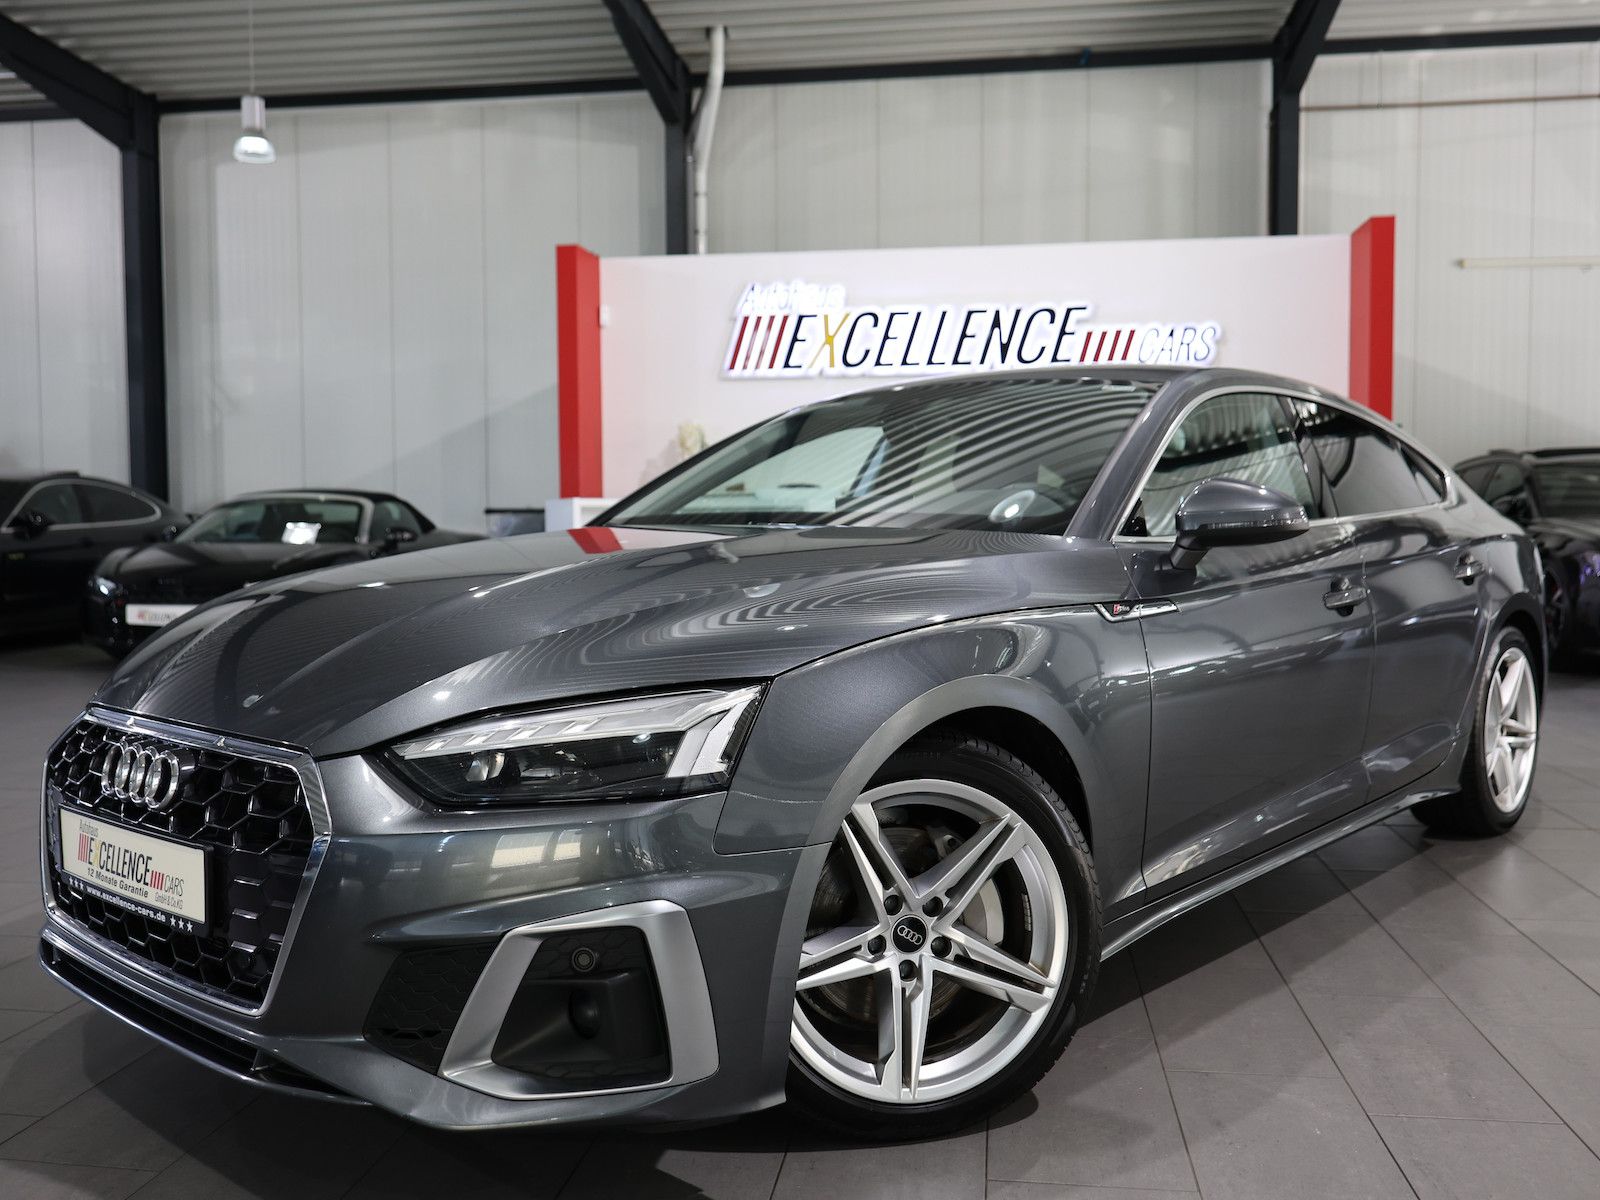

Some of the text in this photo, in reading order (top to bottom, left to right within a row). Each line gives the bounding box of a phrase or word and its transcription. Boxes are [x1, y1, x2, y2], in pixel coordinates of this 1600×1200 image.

[783, 306, 1216, 369] EXCELLENCE CARS
[87, 867, 149, 899] 12 Monate Garantie
[88, 837, 185, 897] EXCELLENCE CARS
[86, 884, 167, 923] www.excellence-cars.de
